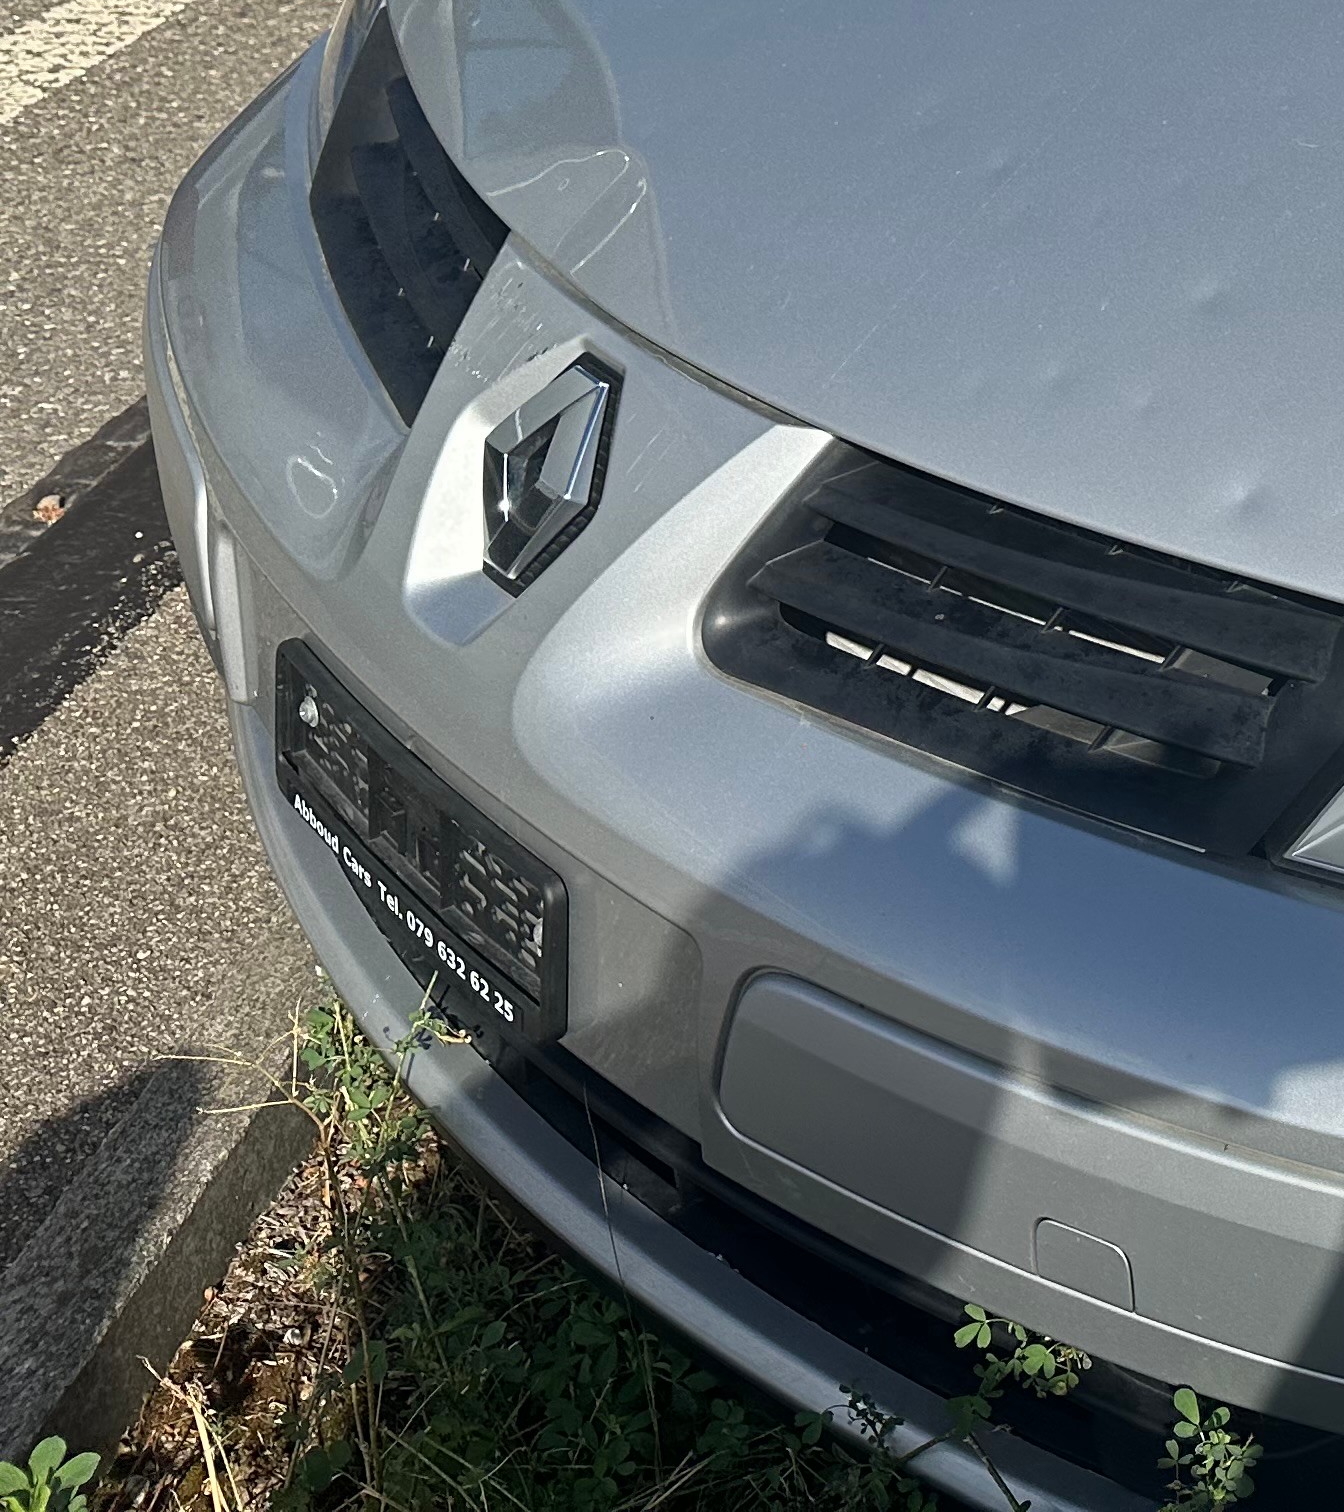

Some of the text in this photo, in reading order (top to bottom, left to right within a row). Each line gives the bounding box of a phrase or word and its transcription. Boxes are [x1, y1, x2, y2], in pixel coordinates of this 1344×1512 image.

[294, 793, 514, 1022] Abboud Cars Tel. 079 632 62 25
